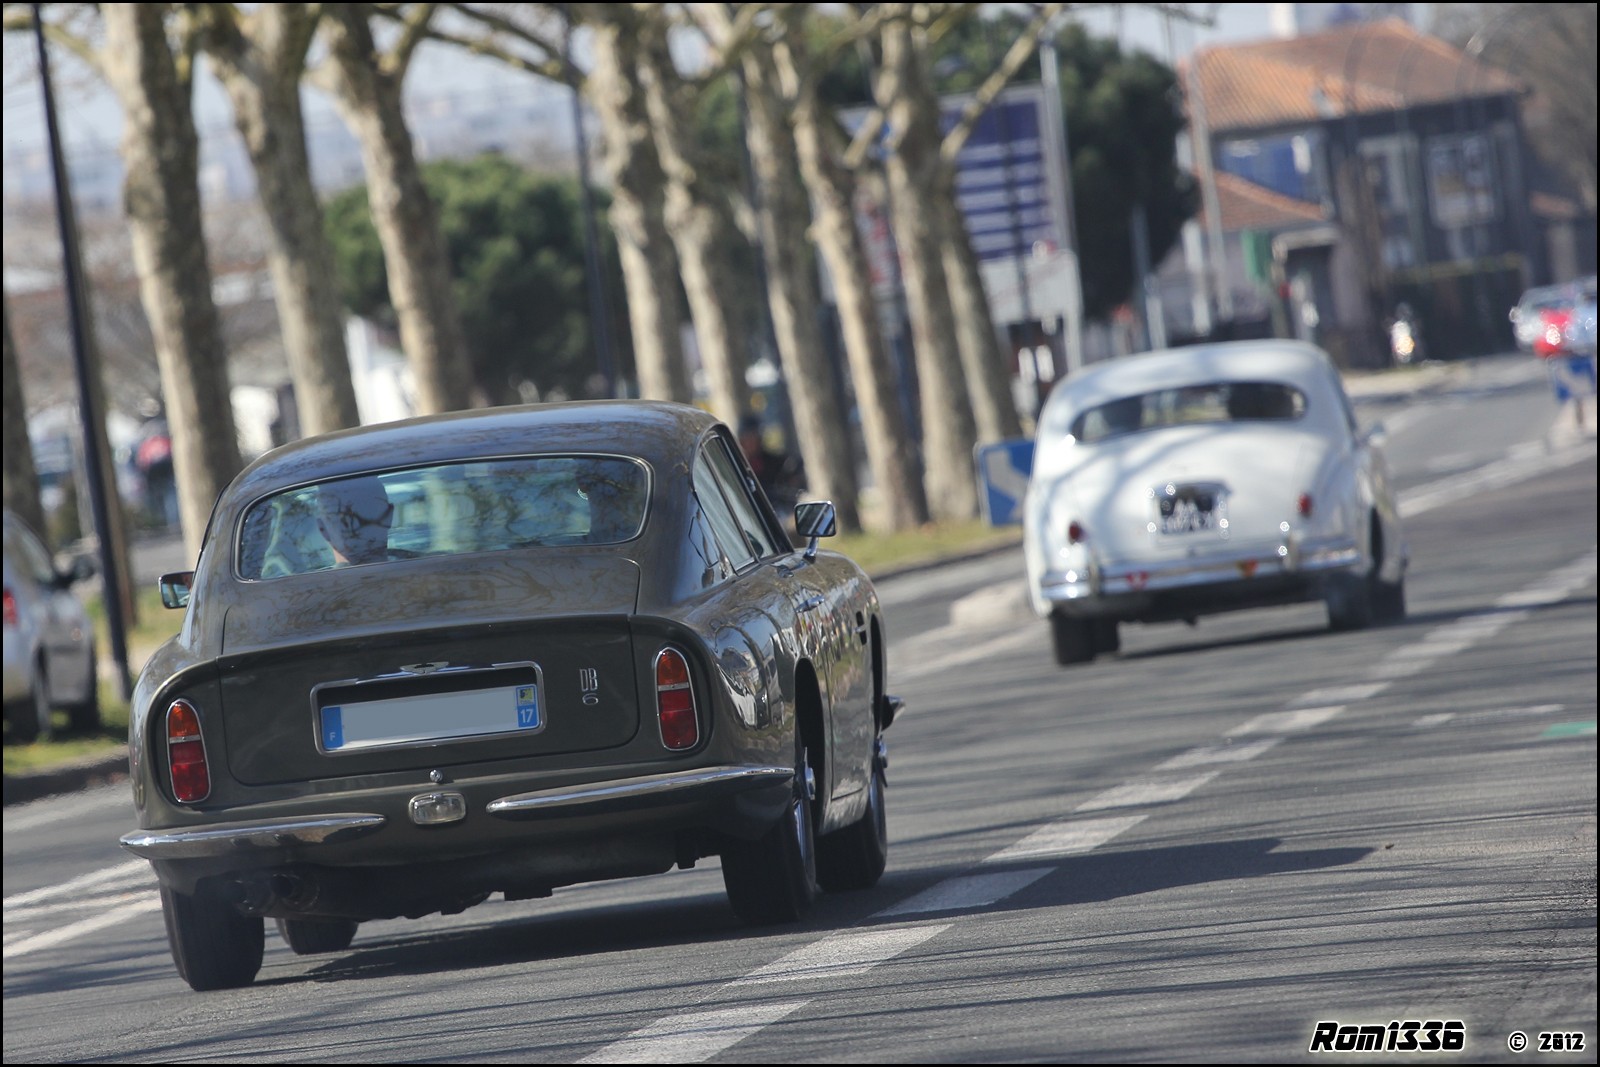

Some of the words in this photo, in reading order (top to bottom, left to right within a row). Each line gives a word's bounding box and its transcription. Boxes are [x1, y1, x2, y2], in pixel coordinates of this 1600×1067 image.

[579, 667, 598, 692] DB
[582, 692, 599, 706] 6
[520, 708, 534, 724] 17
[329, 731, 337, 742] F
